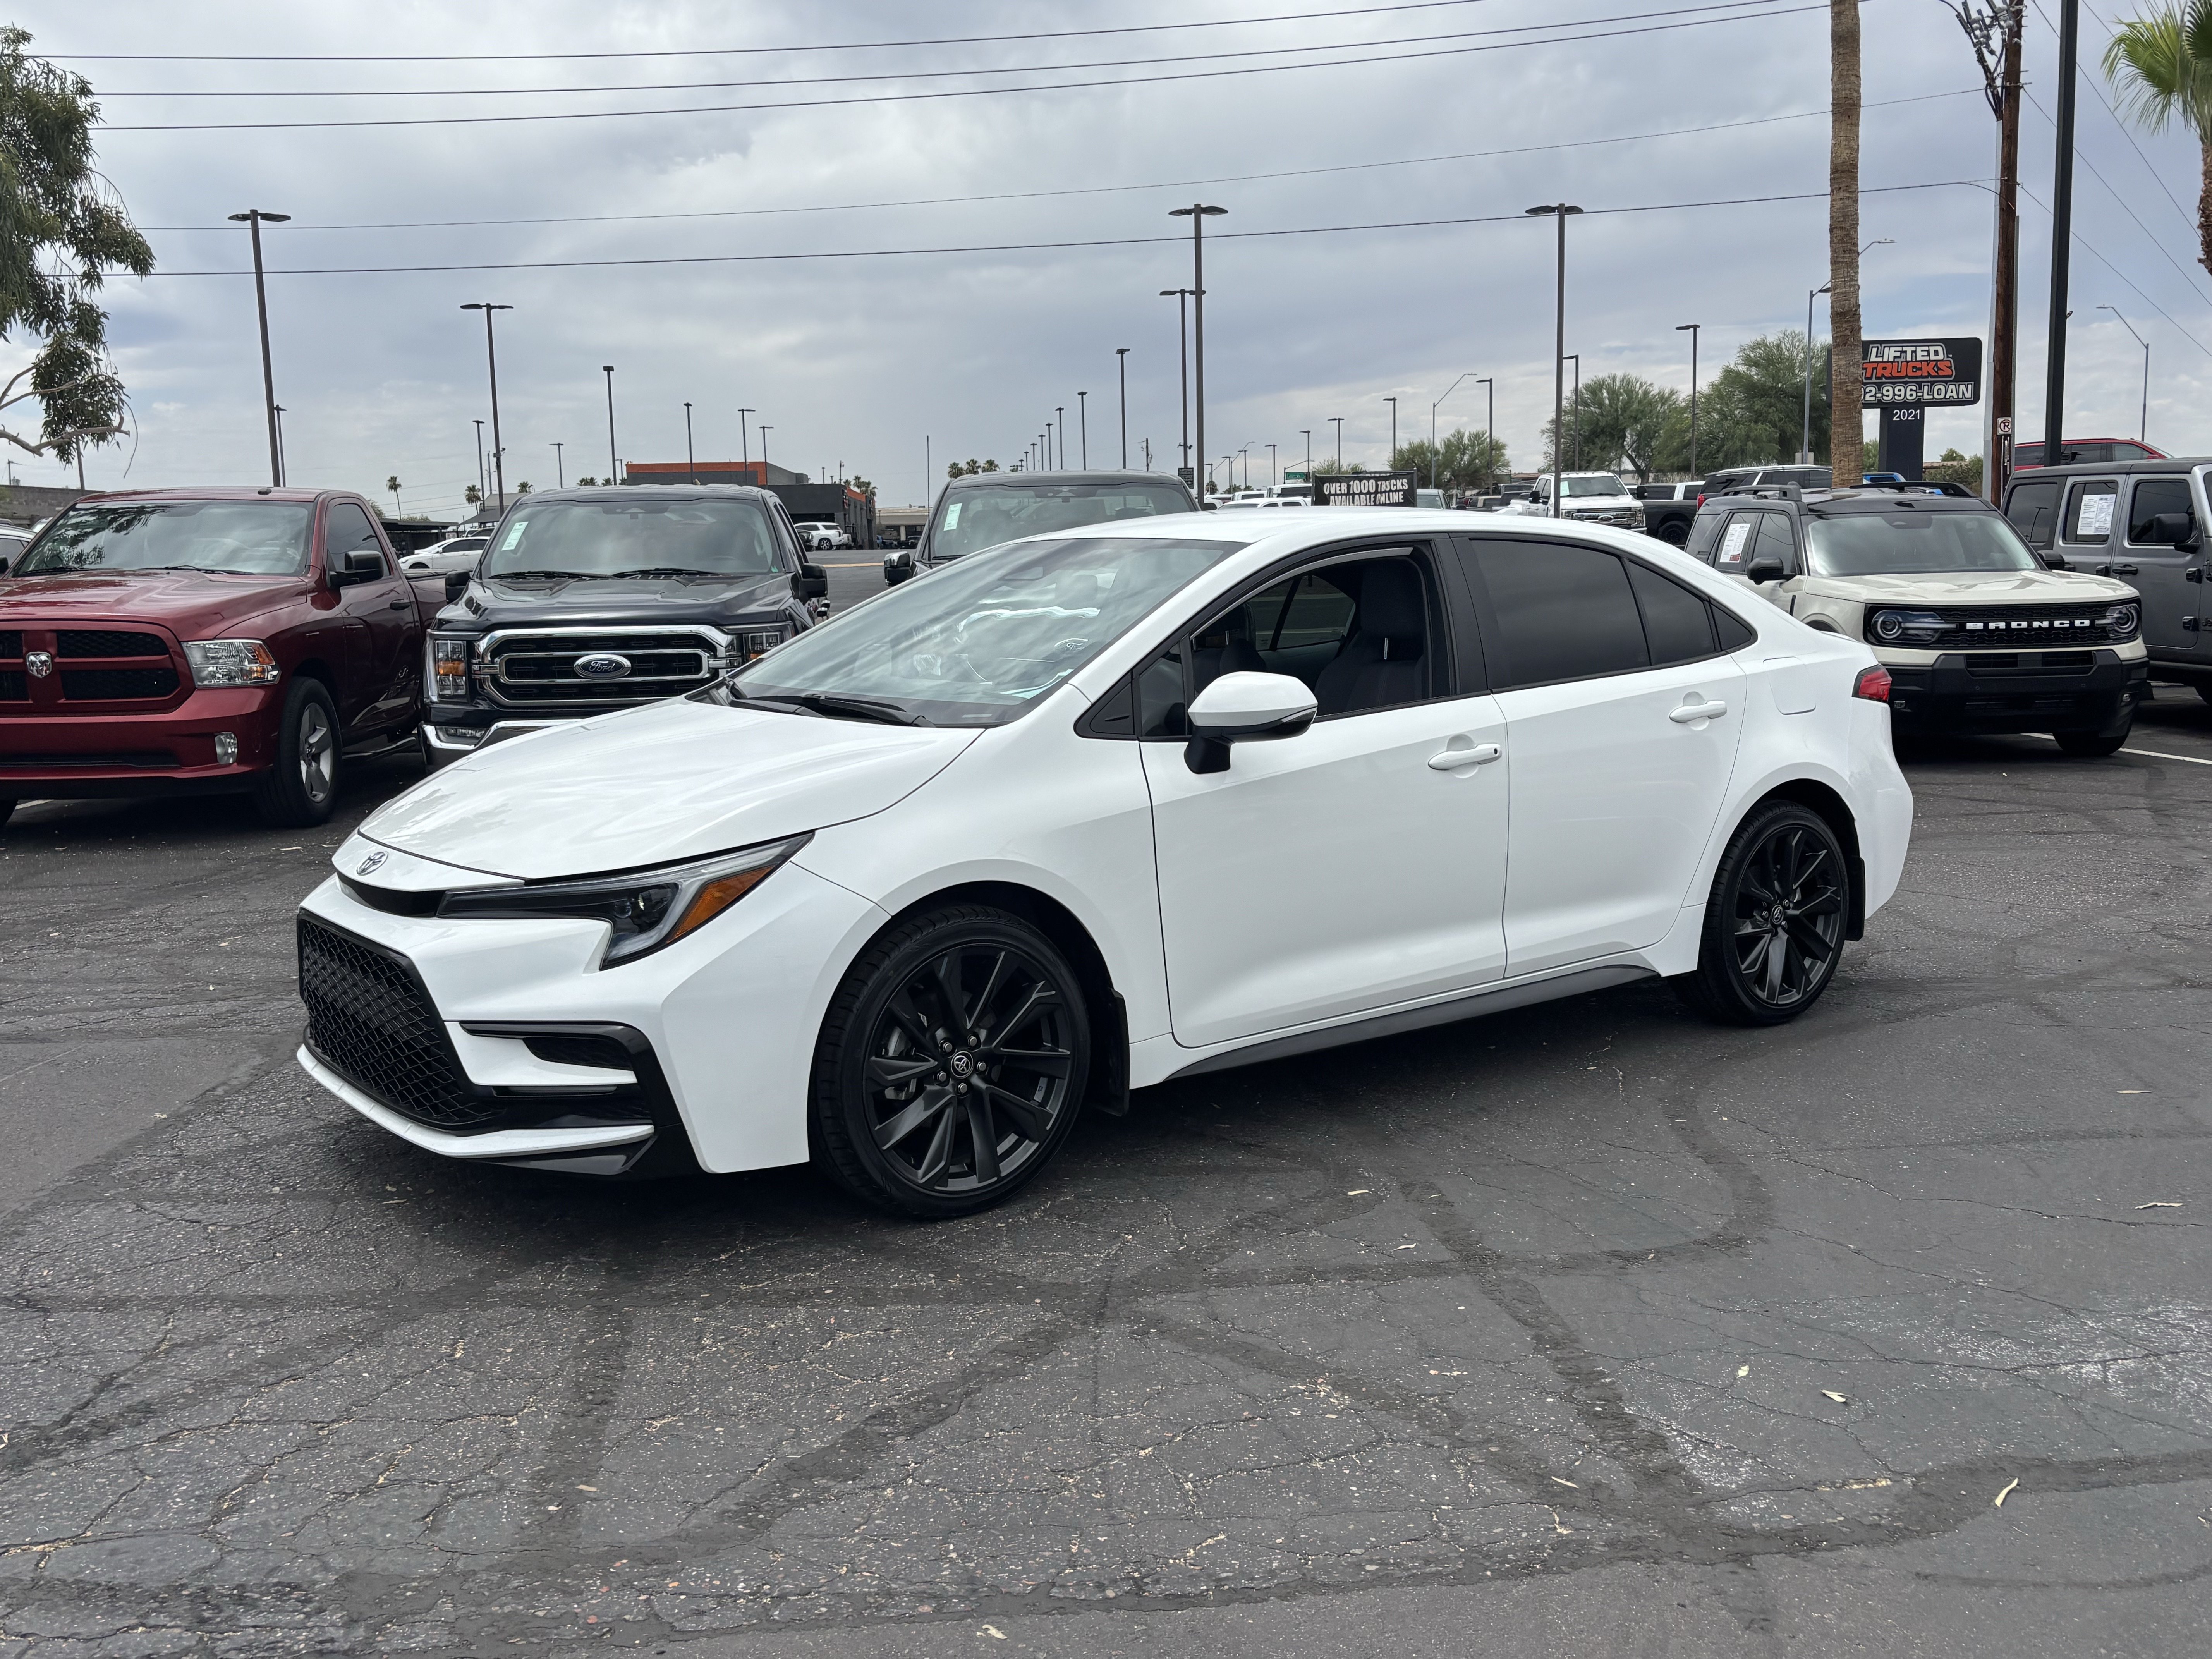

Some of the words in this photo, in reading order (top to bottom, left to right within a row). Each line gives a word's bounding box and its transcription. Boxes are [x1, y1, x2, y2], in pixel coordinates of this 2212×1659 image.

[1870, 346, 1944, 361] LIFTED
[1863, 361, 1953, 377] TRUCKS
[1862, 385, 1972, 400] 2-996-LOAN
[1893, 409, 1920, 421] 2021
[1323, 483, 1348, 495] OVER
[1349, 479, 1376, 494] 1000
[1377, 479, 1408, 492] TRUCKS
[1329, 494, 1375, 506] AVAILABLE
[1376, 491, 1404, 505] ONLINE
[1966, 620, 2090, 629] BRONCO
[589, 661, 615, 671] Ford
